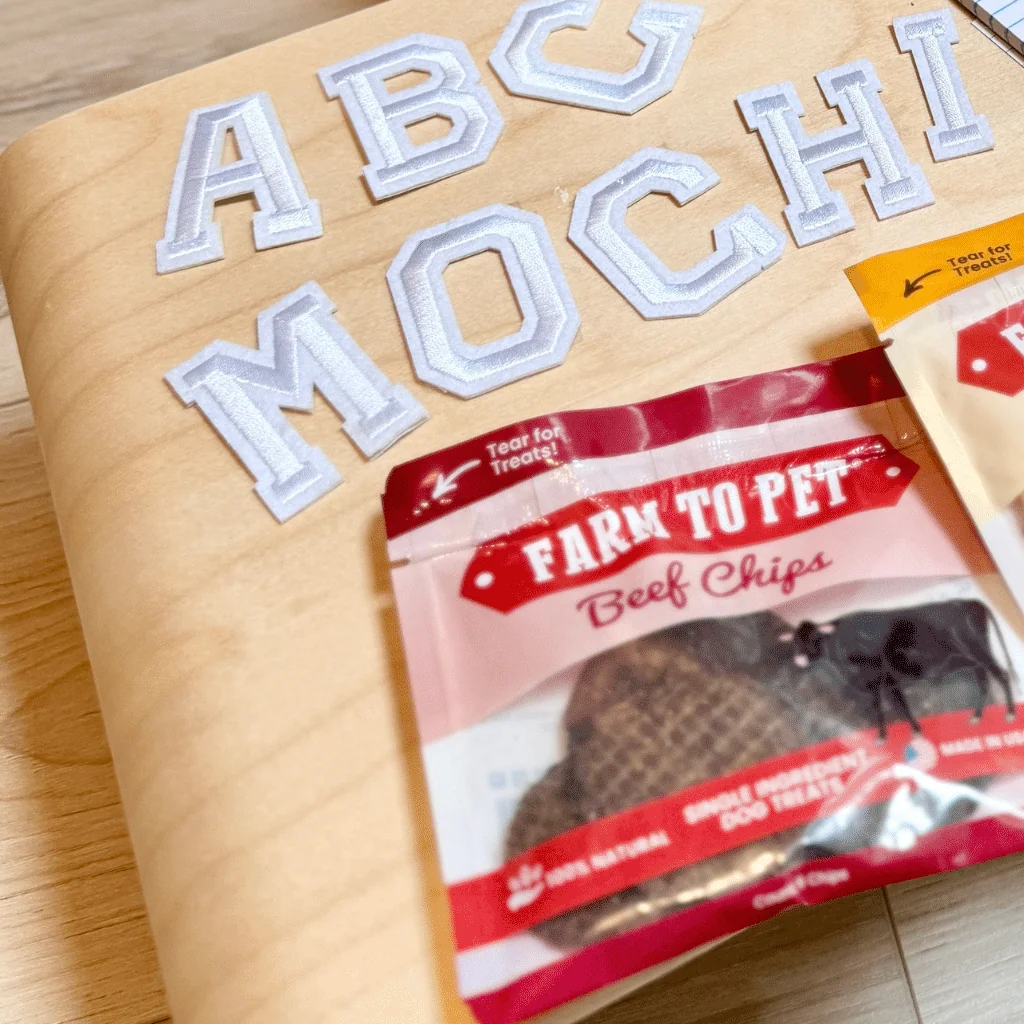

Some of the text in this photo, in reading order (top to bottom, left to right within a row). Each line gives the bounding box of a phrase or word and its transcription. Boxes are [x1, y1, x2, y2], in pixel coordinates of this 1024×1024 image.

[163, 7, 994, 523] MOCHI
[947, 243, 1011, 267] Tear for
[953, 252, 1013, 277] Treats!
[486, 426, 560, 458] Tear for
[490, 441, 558, 476] Treats!
[522, 501, 671, 584] FARM
[675, 481, 746, 540] TO
[576, 550, 833, 629] Beef Chips
[720, 776, 846, 831] DOG TREATS
[590, 828, 671, 869] NATURAL
